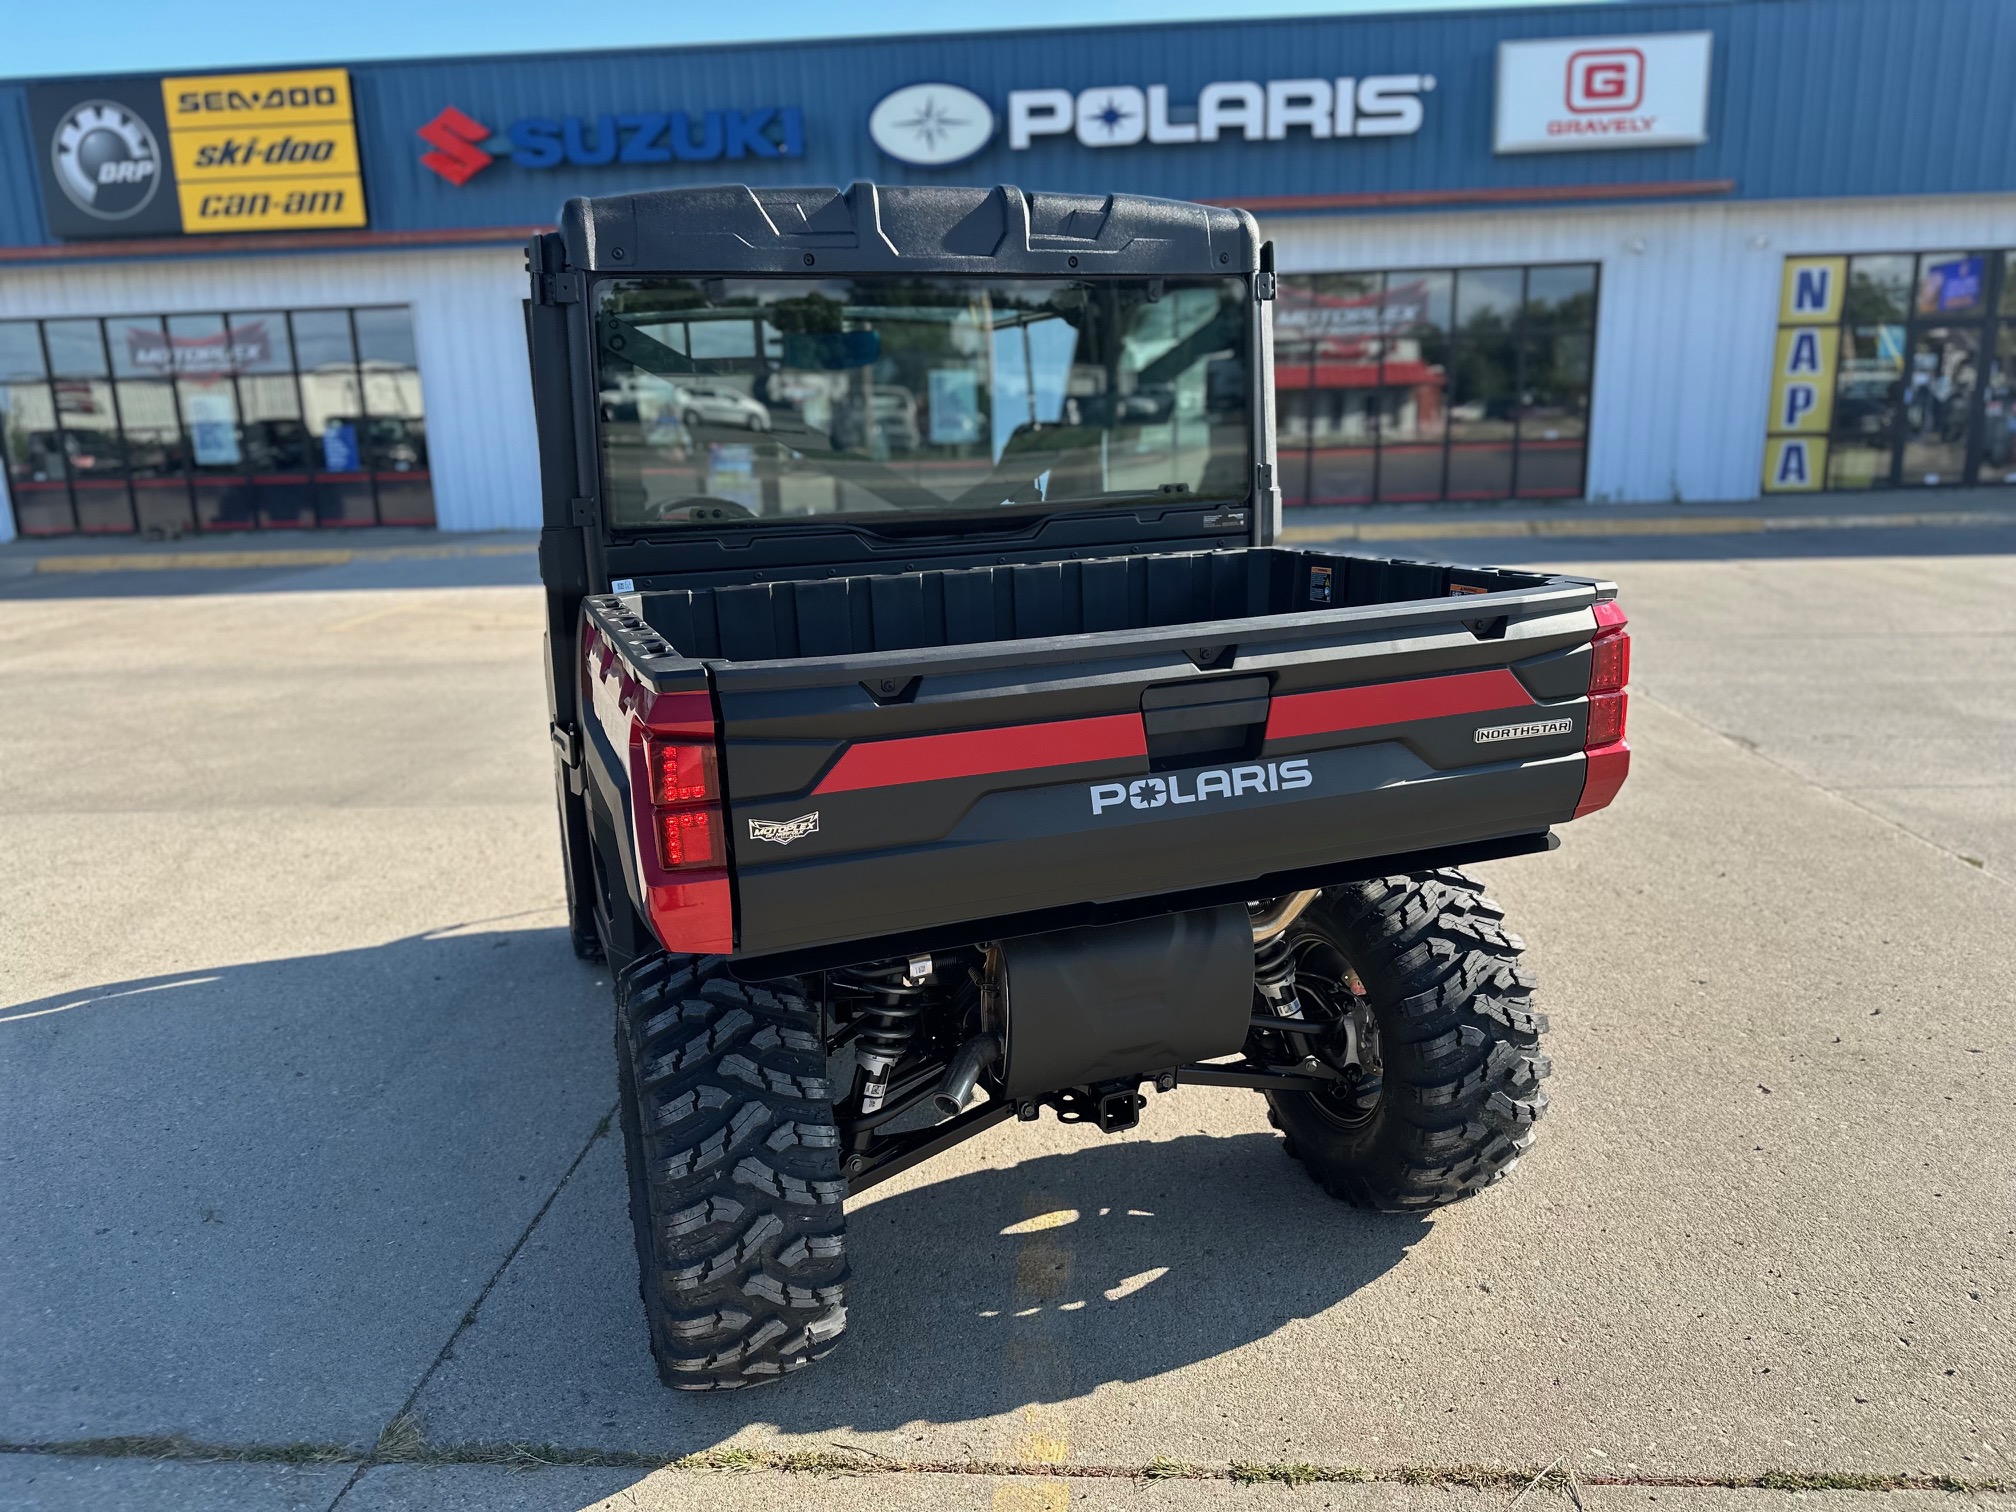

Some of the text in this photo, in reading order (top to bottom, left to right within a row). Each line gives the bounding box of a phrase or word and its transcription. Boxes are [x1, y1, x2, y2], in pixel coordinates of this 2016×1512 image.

[508, 106, 805, 169] SUZUKI
[1009, 75, 1423, 149] POLARIS
[1547, 117, 1656, 136] GRAVELY
[1777, 269, 1829, 482] NAPA
[1480, 721, 1568, 741] NORTHSTAR
[1090, 759, 1313, 815] POLARIS
[754, 822, 815, 836] MOTOPLEX
